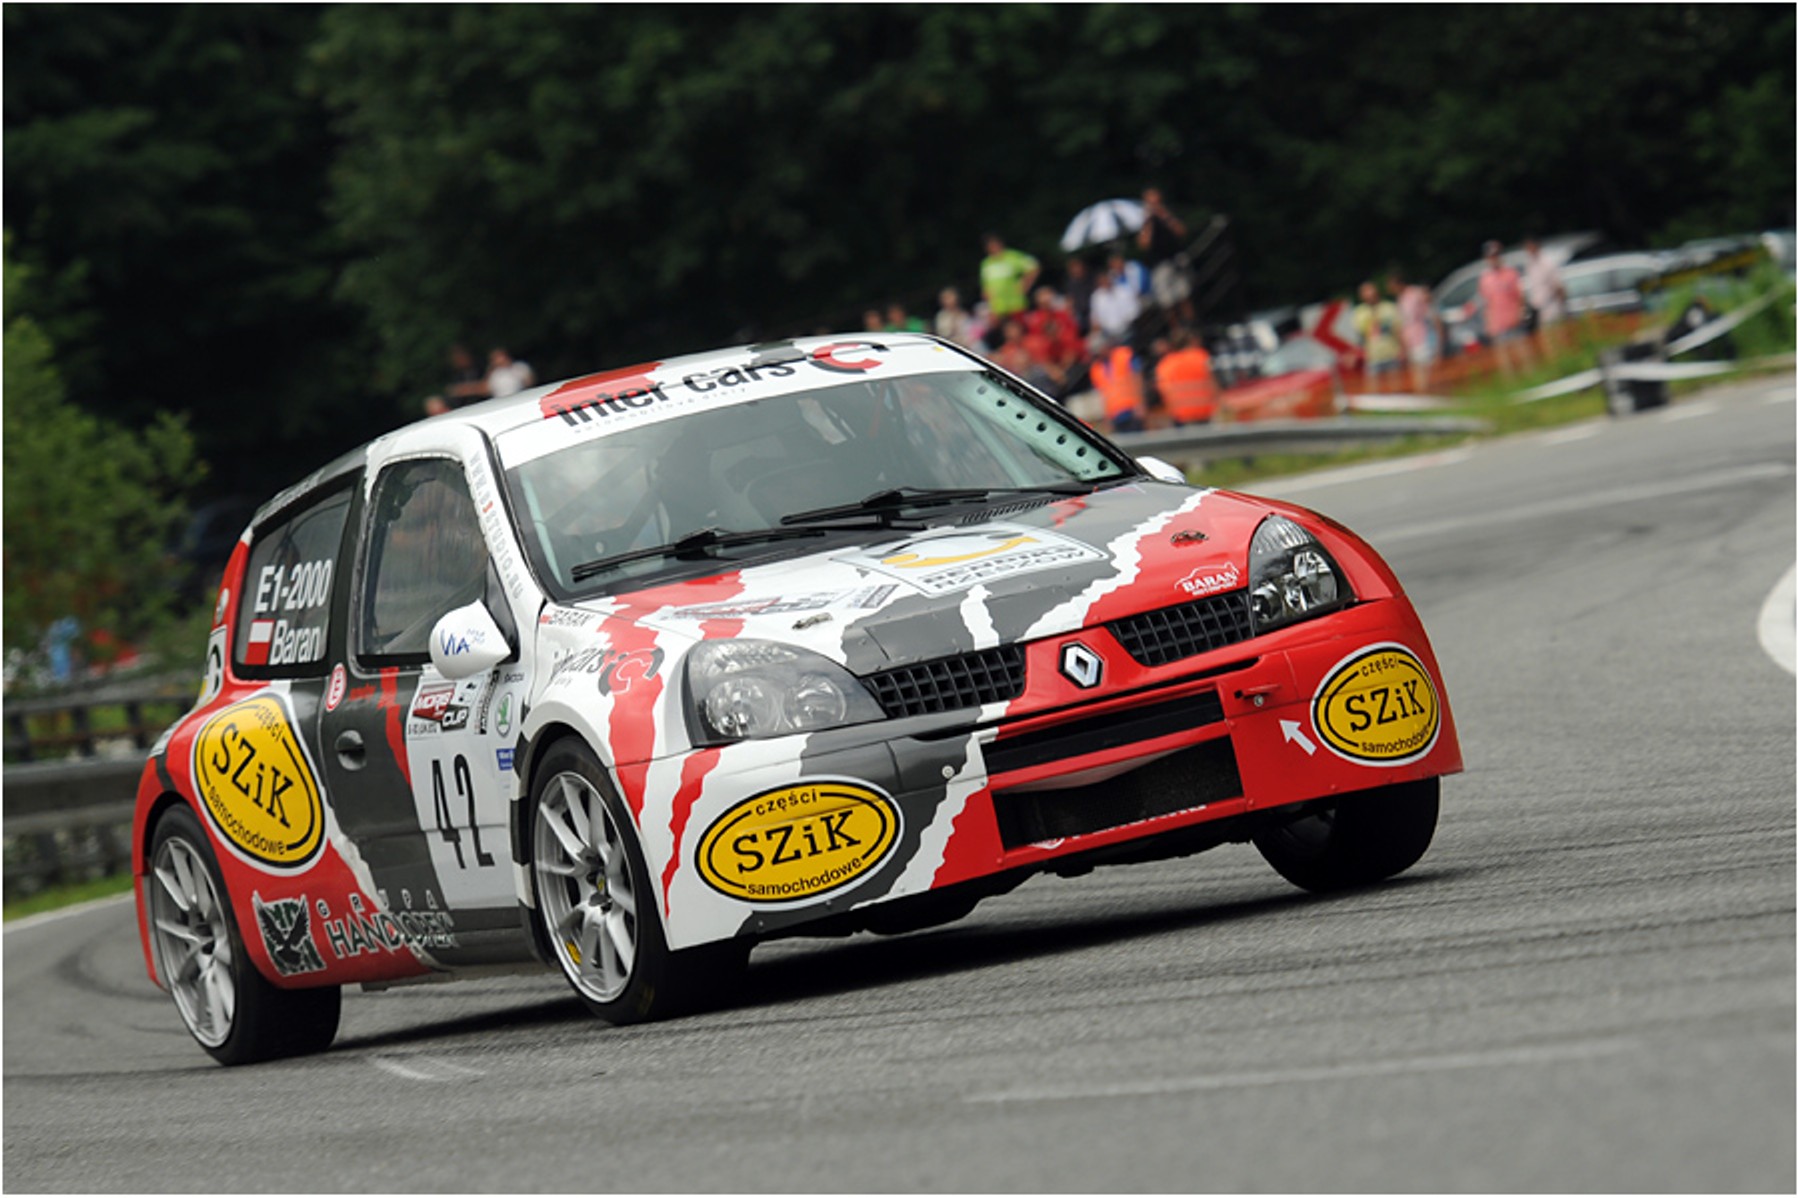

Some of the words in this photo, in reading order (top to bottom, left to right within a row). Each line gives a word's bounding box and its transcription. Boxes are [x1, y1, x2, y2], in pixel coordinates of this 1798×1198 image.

[552, 380, 669, 427] inter
[683, 358, 796, 392] cars
[255, 559, 332, 613] E1-2000
[1182, 571, 1238, 593] BARAN
[269, 619, 321, 666] Baran
[1361, 655, 1399, 677] części
[442, 706, 468, 728] CUP
[1345, 679, 1425, 732] SZiK
[212, 722, 293, 829] SZiK
[755, 788, 817, 816] części
[208, 785, 285, 855] samochodowe
[432, 753, 495, 870] 42
[732, 810, 861, 874] SZiK
[747, 856, 862, 896] samochodowe
